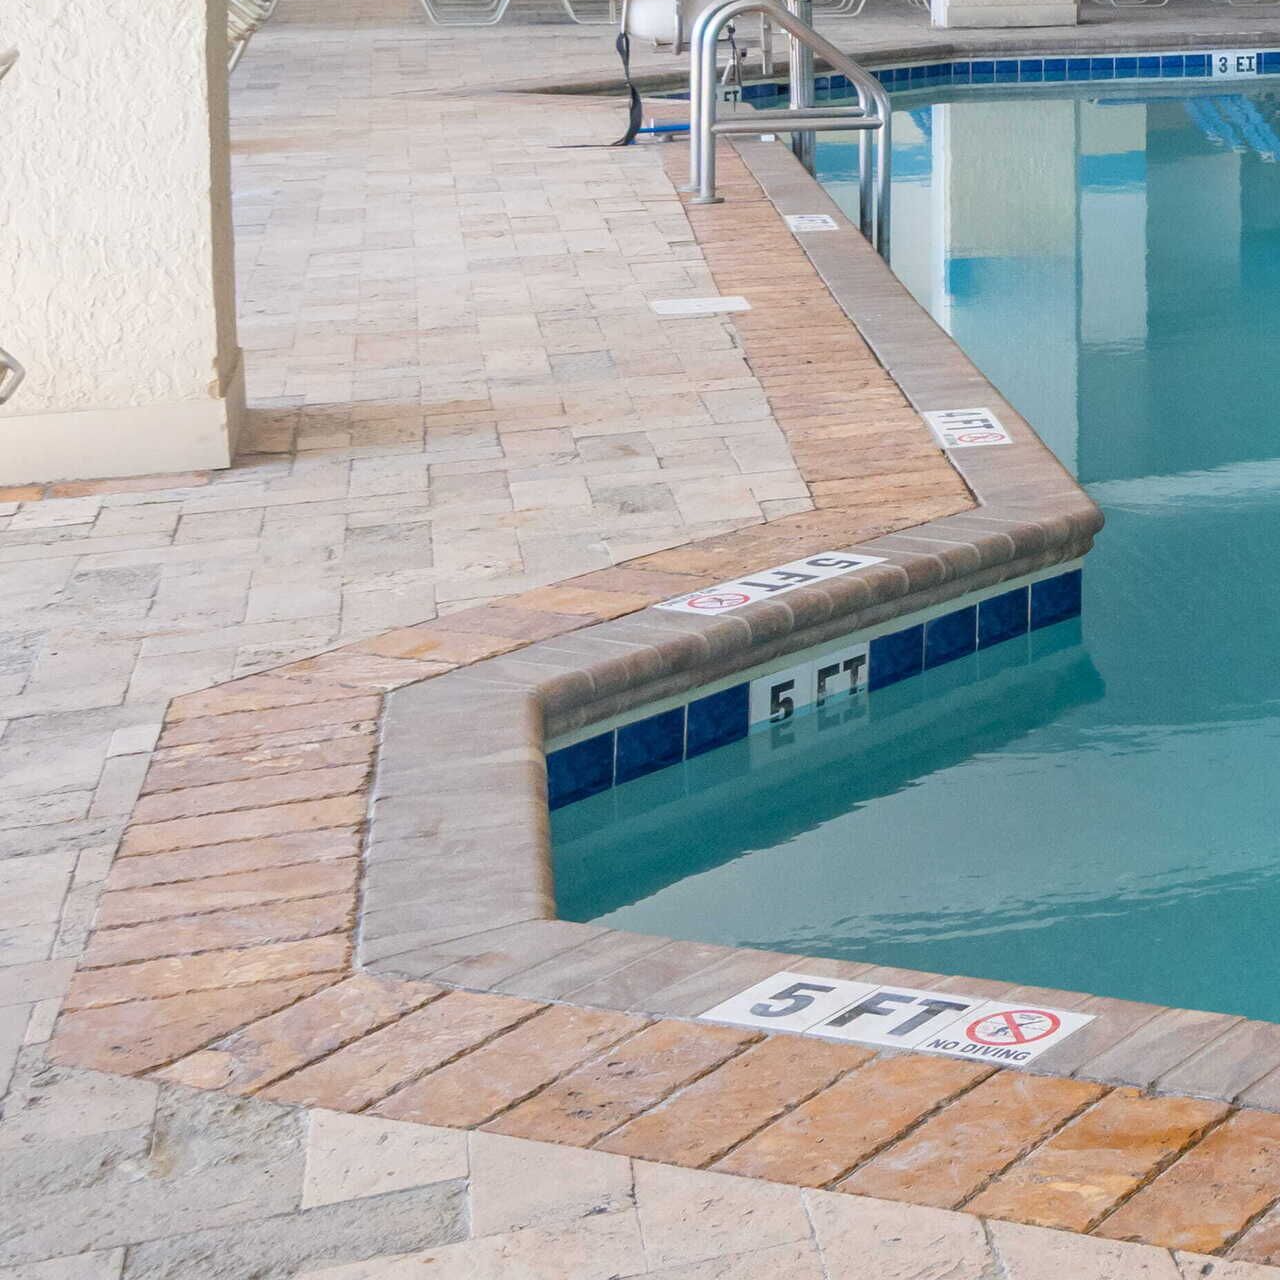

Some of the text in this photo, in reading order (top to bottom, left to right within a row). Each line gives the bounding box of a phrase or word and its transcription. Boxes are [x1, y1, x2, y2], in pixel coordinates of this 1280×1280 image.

[739, 558, 862, 592] 5 FT
[770, 679, 795, 724] 5
[750, 982, 970, 1036] 5 FT
[927, 1038, 1033, 1061] NO DIVING
